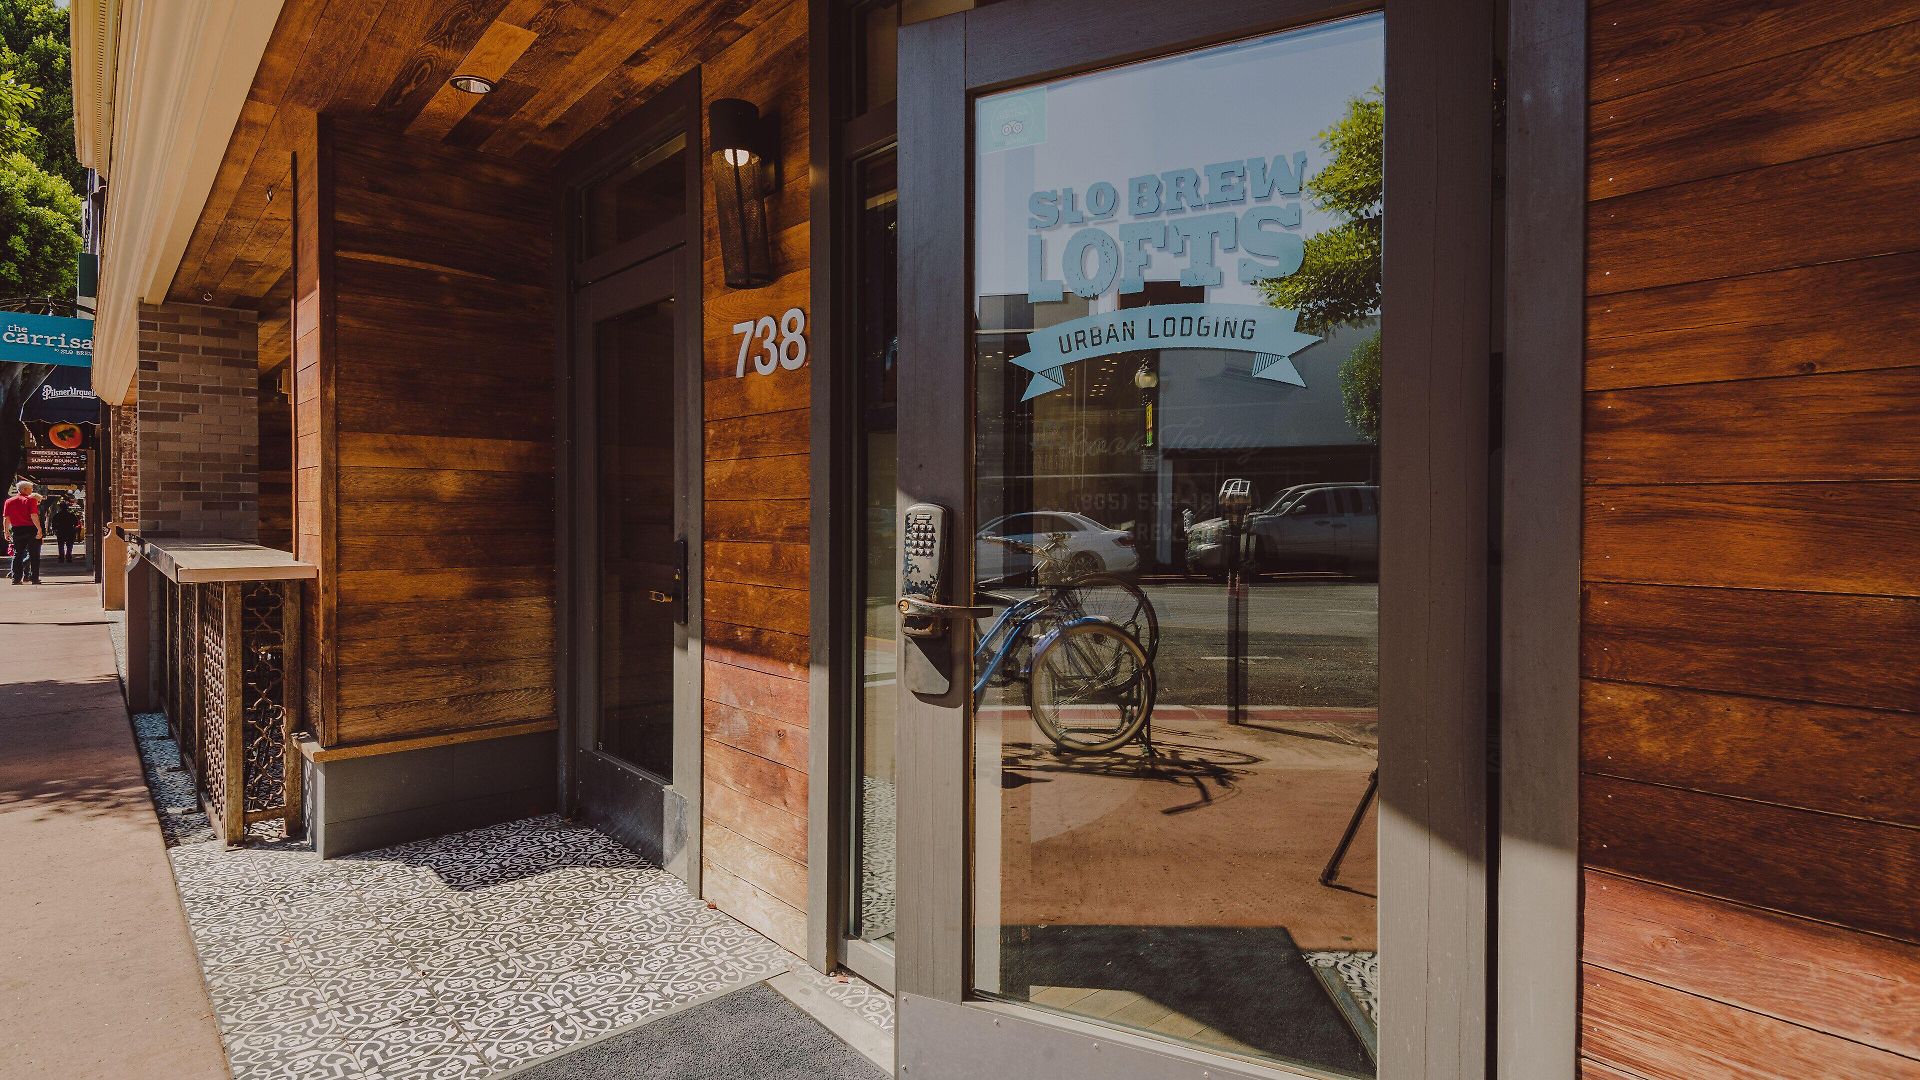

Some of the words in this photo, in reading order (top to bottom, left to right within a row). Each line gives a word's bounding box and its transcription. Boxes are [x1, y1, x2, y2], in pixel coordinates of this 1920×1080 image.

[1028, 182, 1118, 230] SLO
[1128, 151, 1307, 217] BREW
[1028, 203, 1305, 303] LOFTS
[8, 324, 28, 333] the
[733, 308, 806, 378] 738
[1059, 320, 1136, 354] URBAN
[1147, 316, 1257, 340] LODGING
[42, 385, 70, 400] Pilsner
